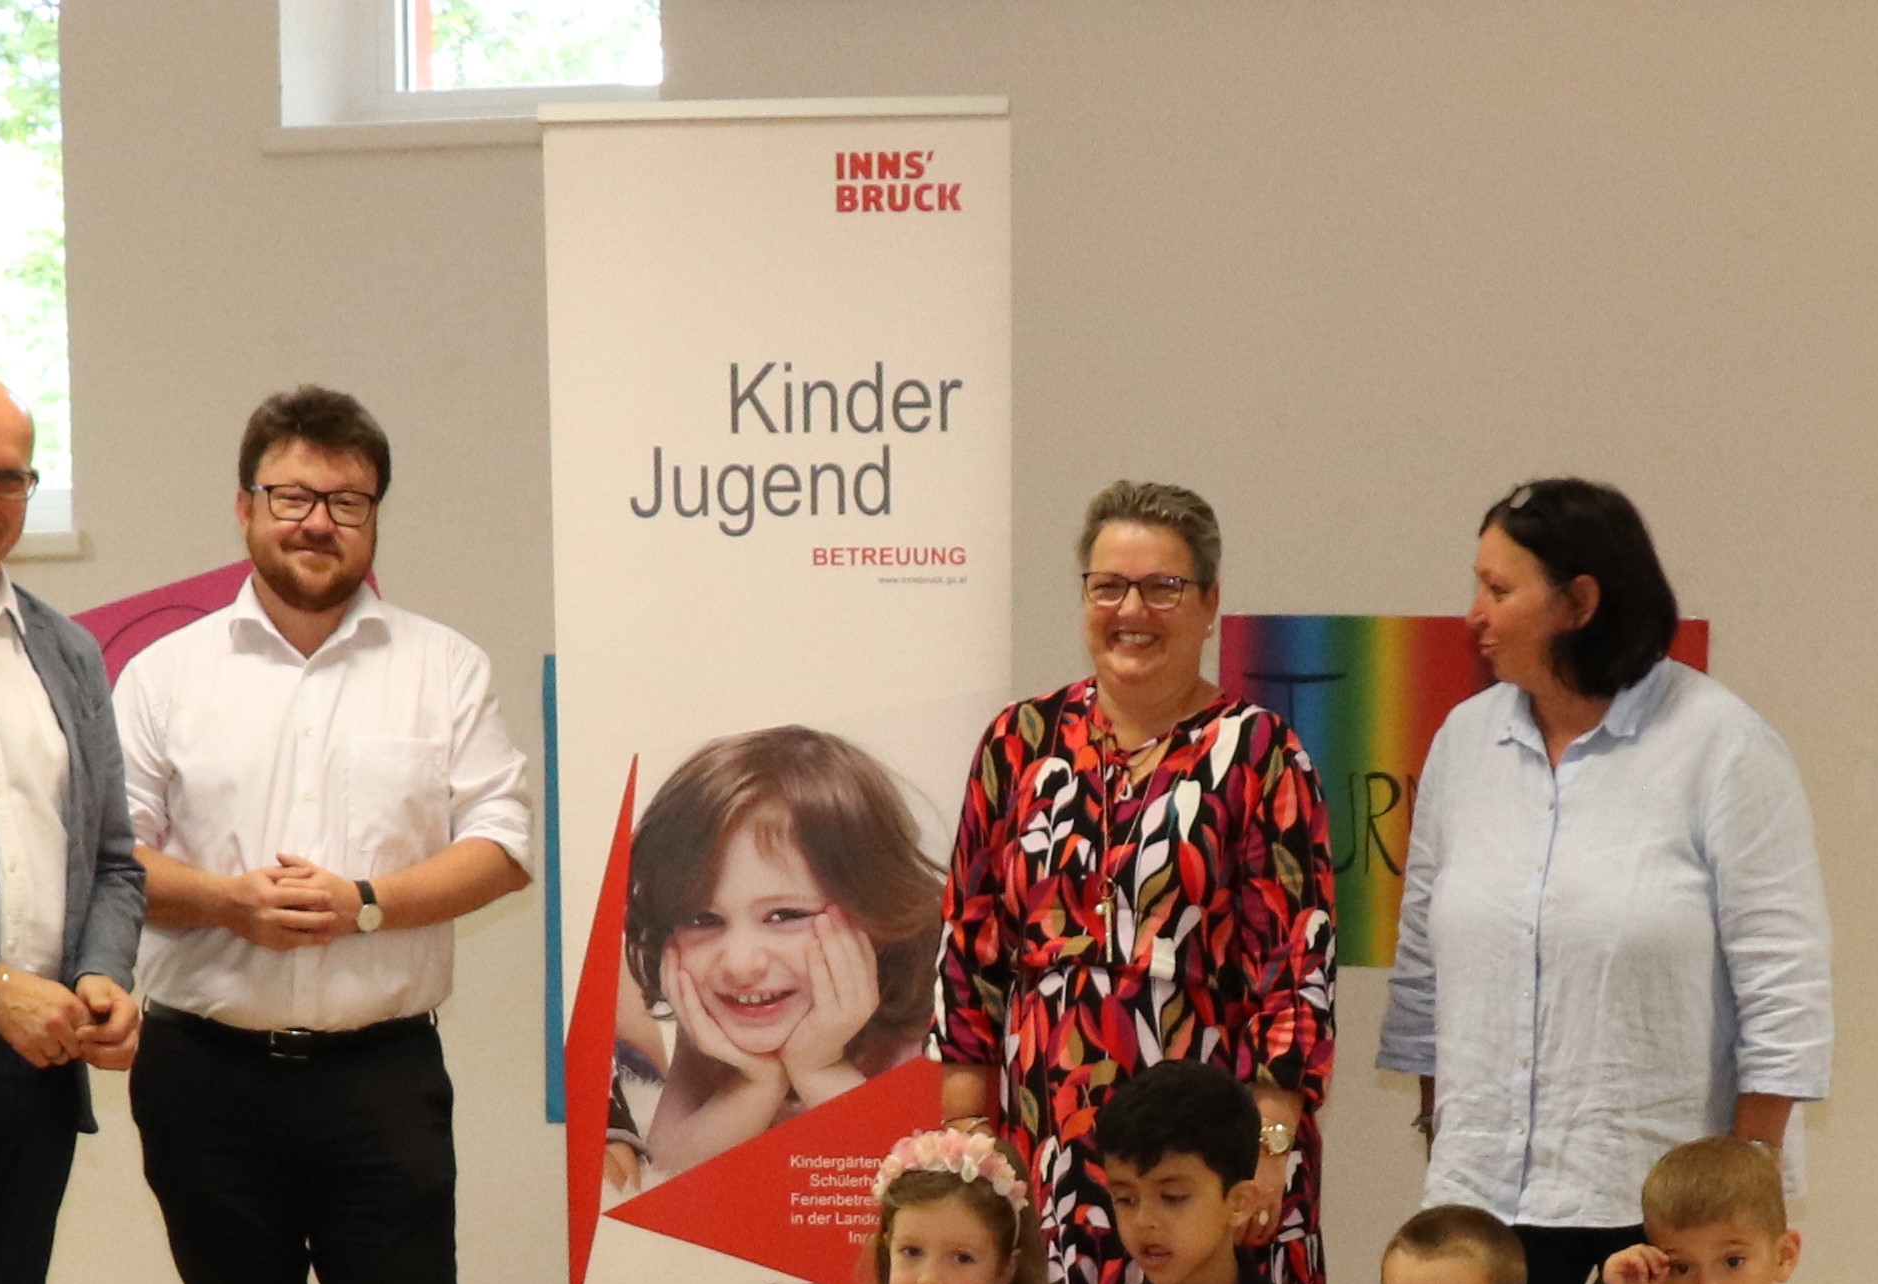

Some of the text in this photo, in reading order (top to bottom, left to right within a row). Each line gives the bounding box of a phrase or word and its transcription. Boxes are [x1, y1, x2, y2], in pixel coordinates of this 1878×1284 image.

[835, 183, 962, 213] BRUCK
[730, 361, 963, 434] Kinder
[630, 444, 892, 537] Jugend
[812, 547, 967, 566] BETREUUNG
[790, 1212, 803, 1224] in
[807, 1212, 831, 1225] der
